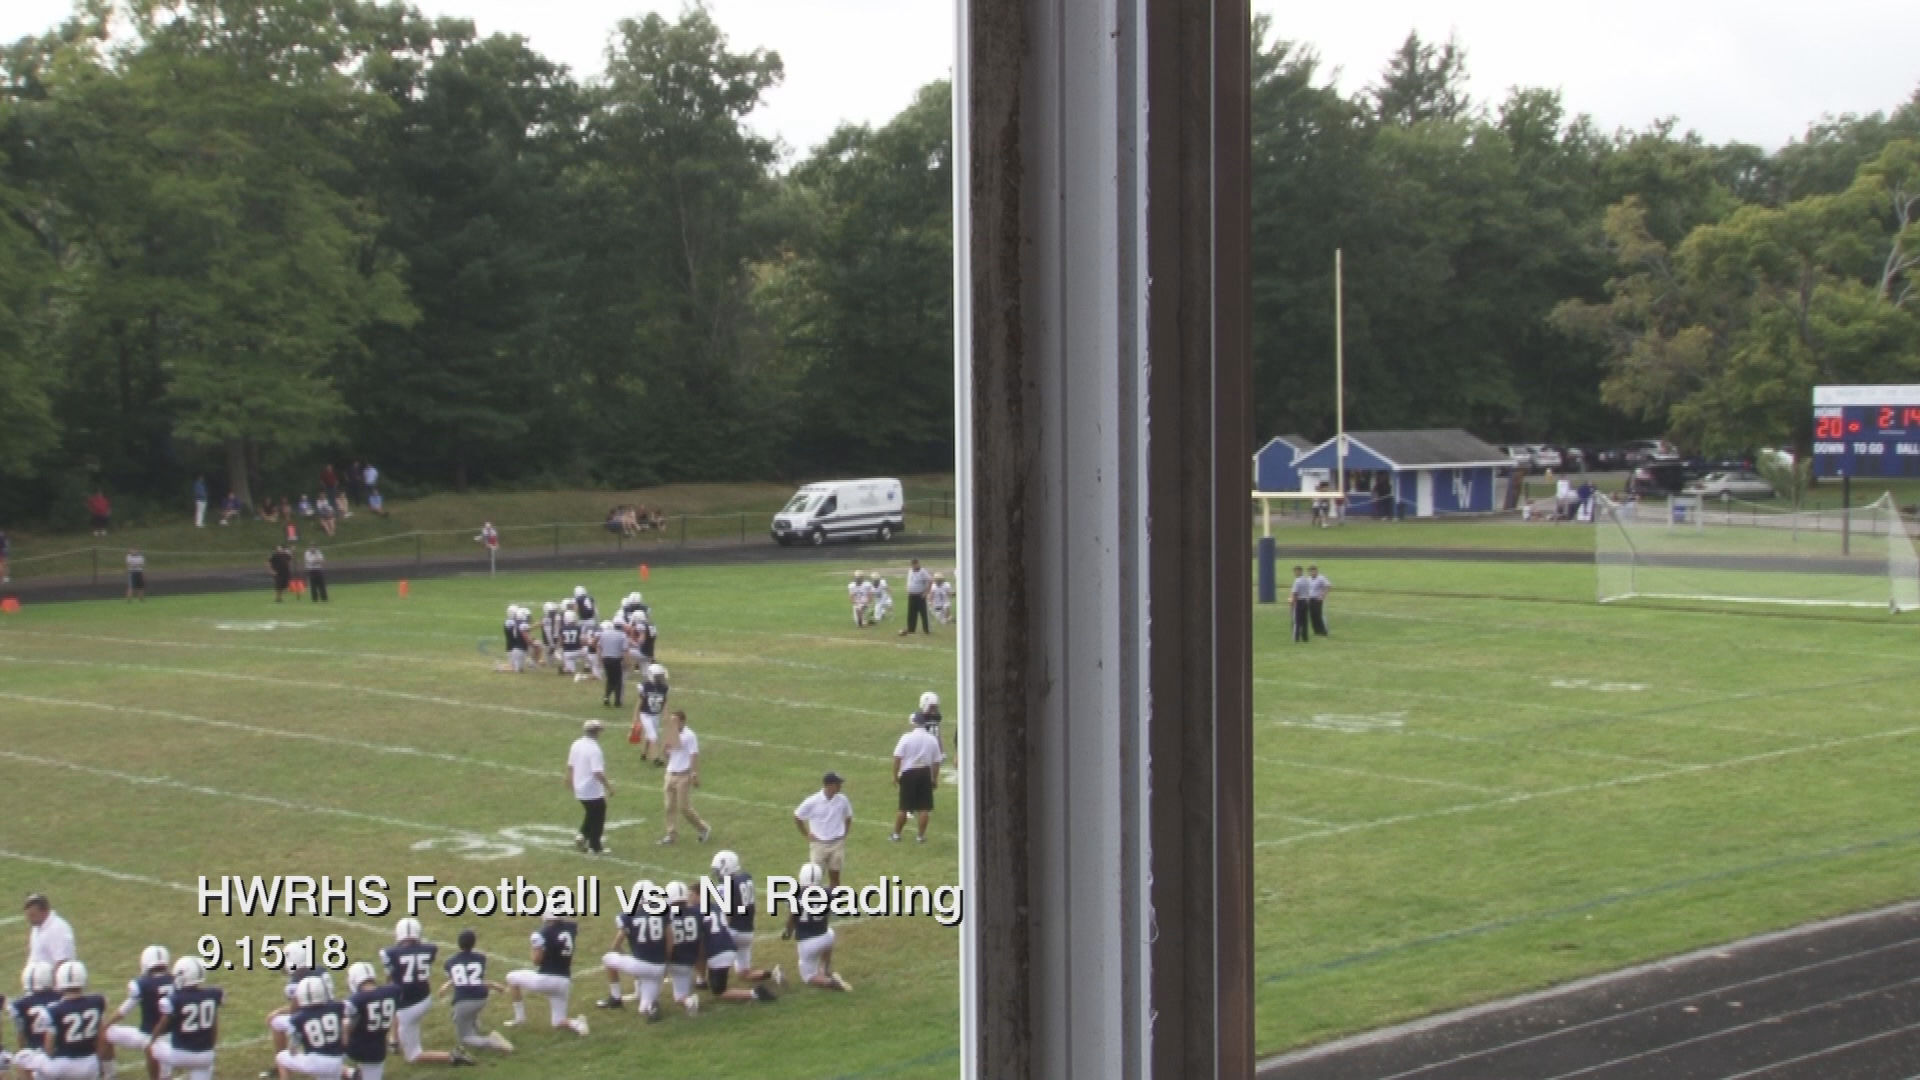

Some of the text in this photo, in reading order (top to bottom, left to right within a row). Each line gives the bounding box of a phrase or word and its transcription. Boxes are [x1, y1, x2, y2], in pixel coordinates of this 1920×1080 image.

[1816, 417, 1843, 439] 20
[1813, 442, 1845, 455] DOWN
[1852, 442, 1884, 455] TO GO
[632, 915, 664, 943] 78
[557, 932, 574, 956] 3
[399, 953, 432, 983] 75
[449, 962, 484, 987] 82
[62, 1008, 101, 1043] 22
[181, 1000, 217, 1033] 20
[366, 998, 397, 1032] 59
[303, 1013, 340, 1048] 89
